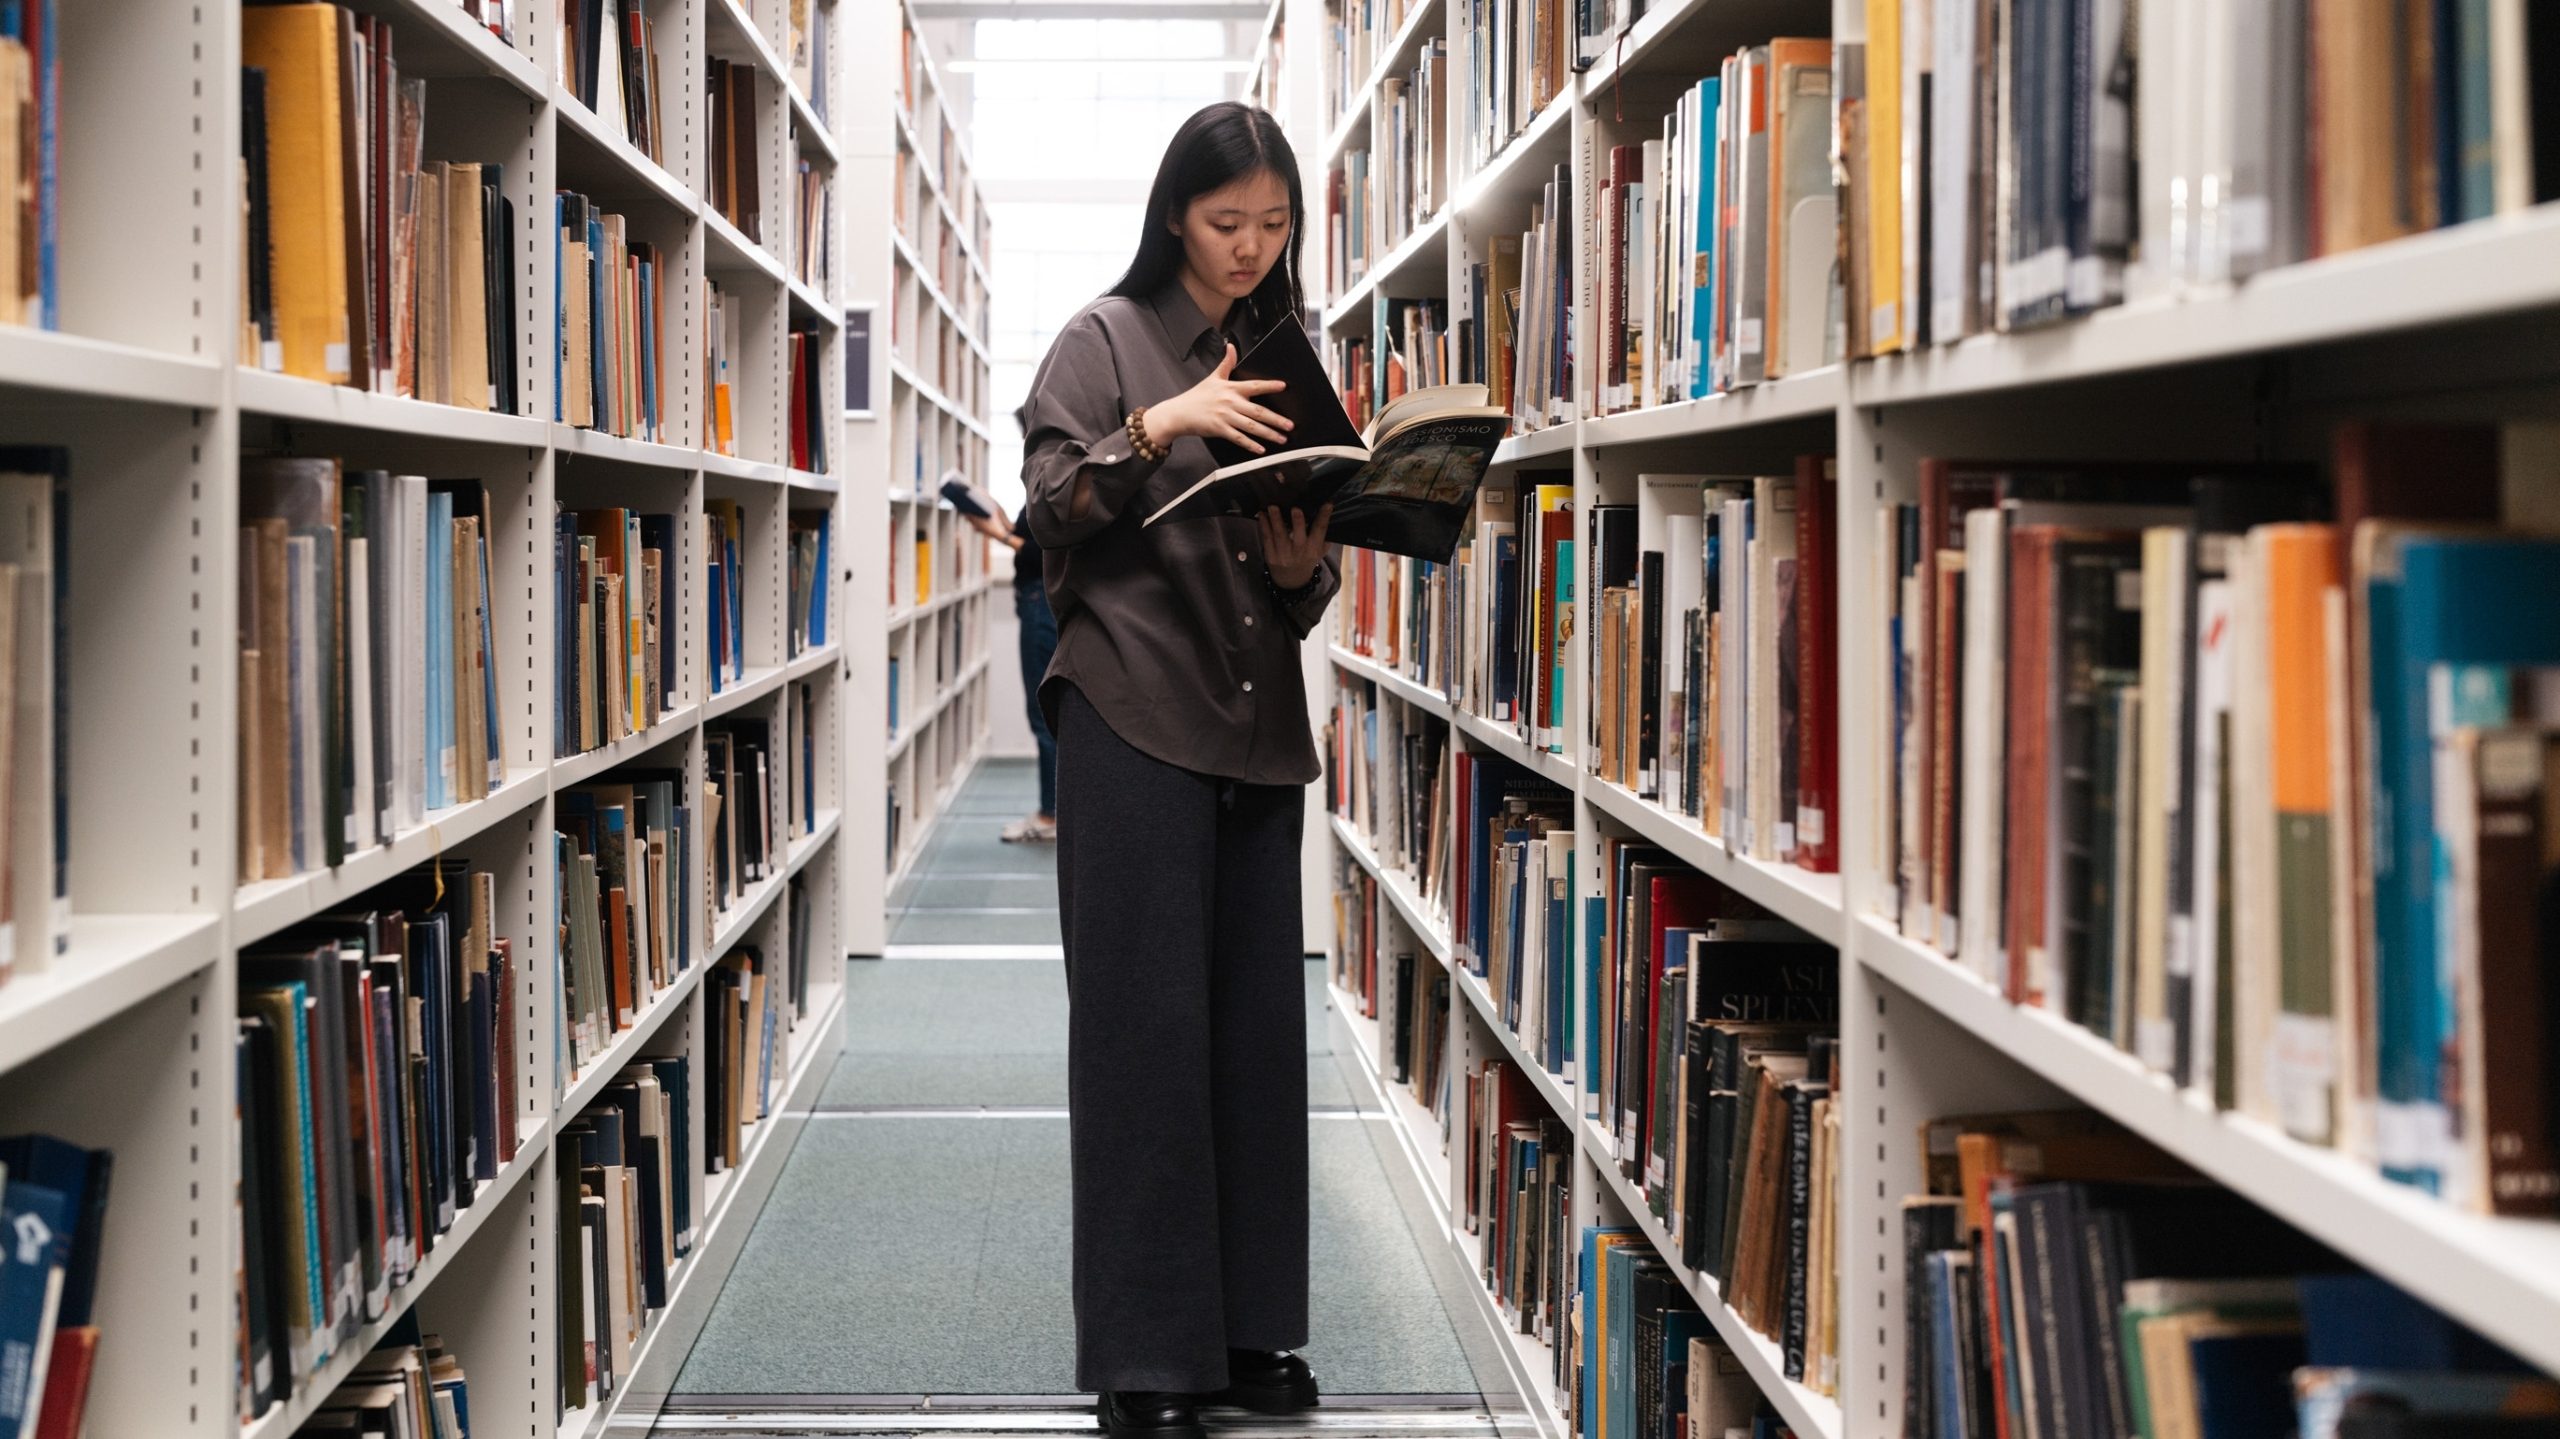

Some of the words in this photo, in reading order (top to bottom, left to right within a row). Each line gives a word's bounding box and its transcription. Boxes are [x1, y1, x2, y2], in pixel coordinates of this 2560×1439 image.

[1583, 135, 1591, 233] PINAKOTHEK
[1583, 239, 1591, 275] NEUE
[1583, 287, 1591, 309] DIE
[1411, 425, 1491, 436] SSIONISMO
[1720, 994, 1839, 1021] SPLEN
